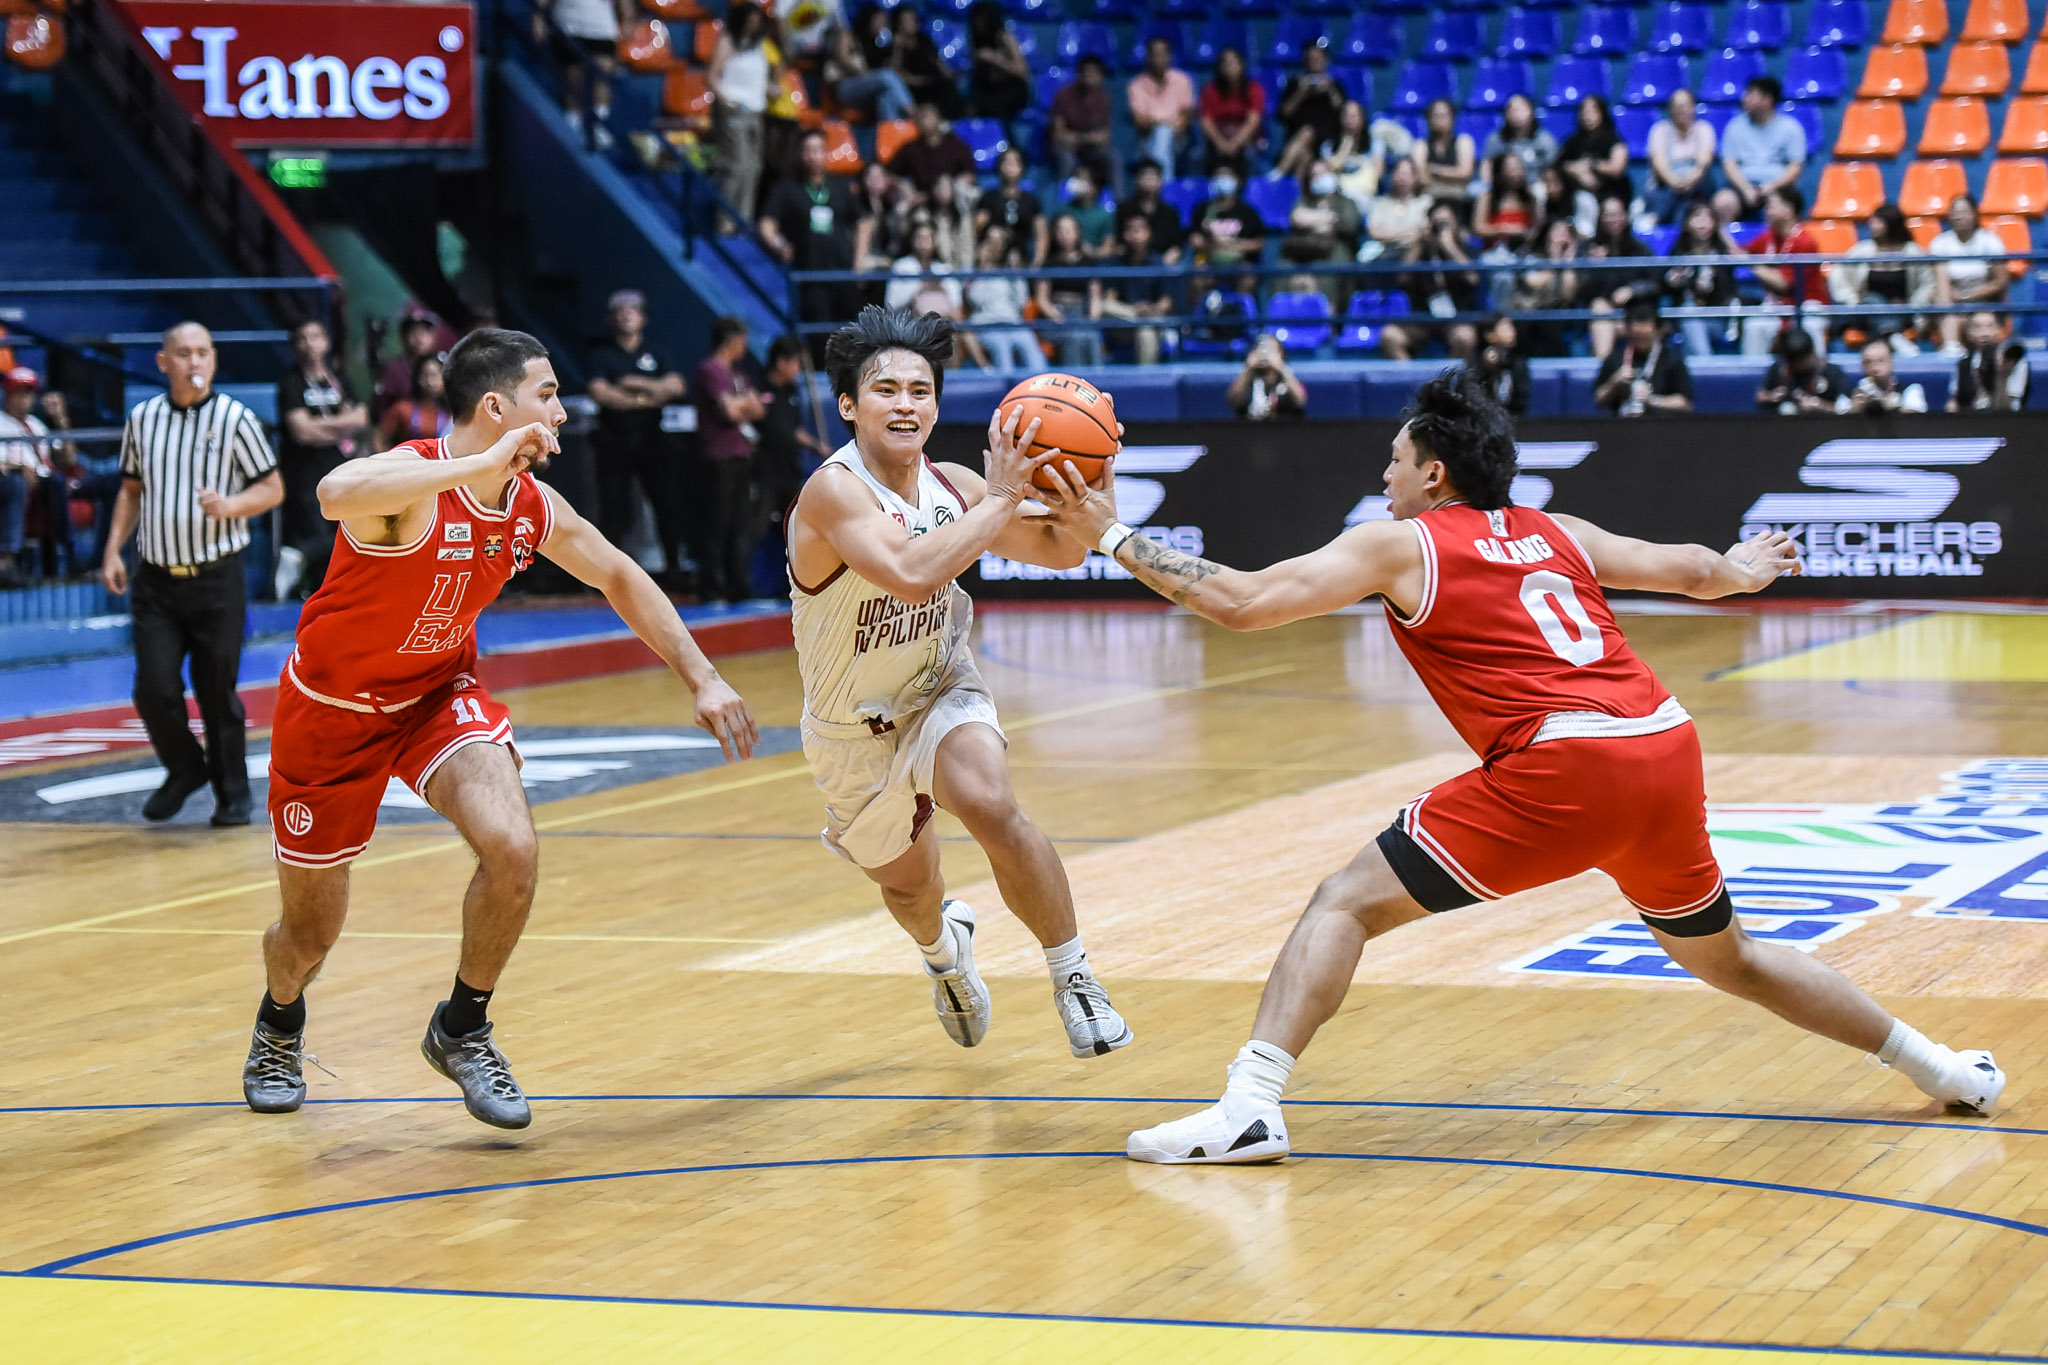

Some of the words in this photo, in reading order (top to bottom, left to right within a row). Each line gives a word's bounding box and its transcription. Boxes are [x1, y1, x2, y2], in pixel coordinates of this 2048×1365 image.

[141, 26, 451, 120] Hanes
[1474, 534, 1555, 565] GALANG
[1519, 569, 1605, 668] 0
[451, 697, 489, 726] 11
